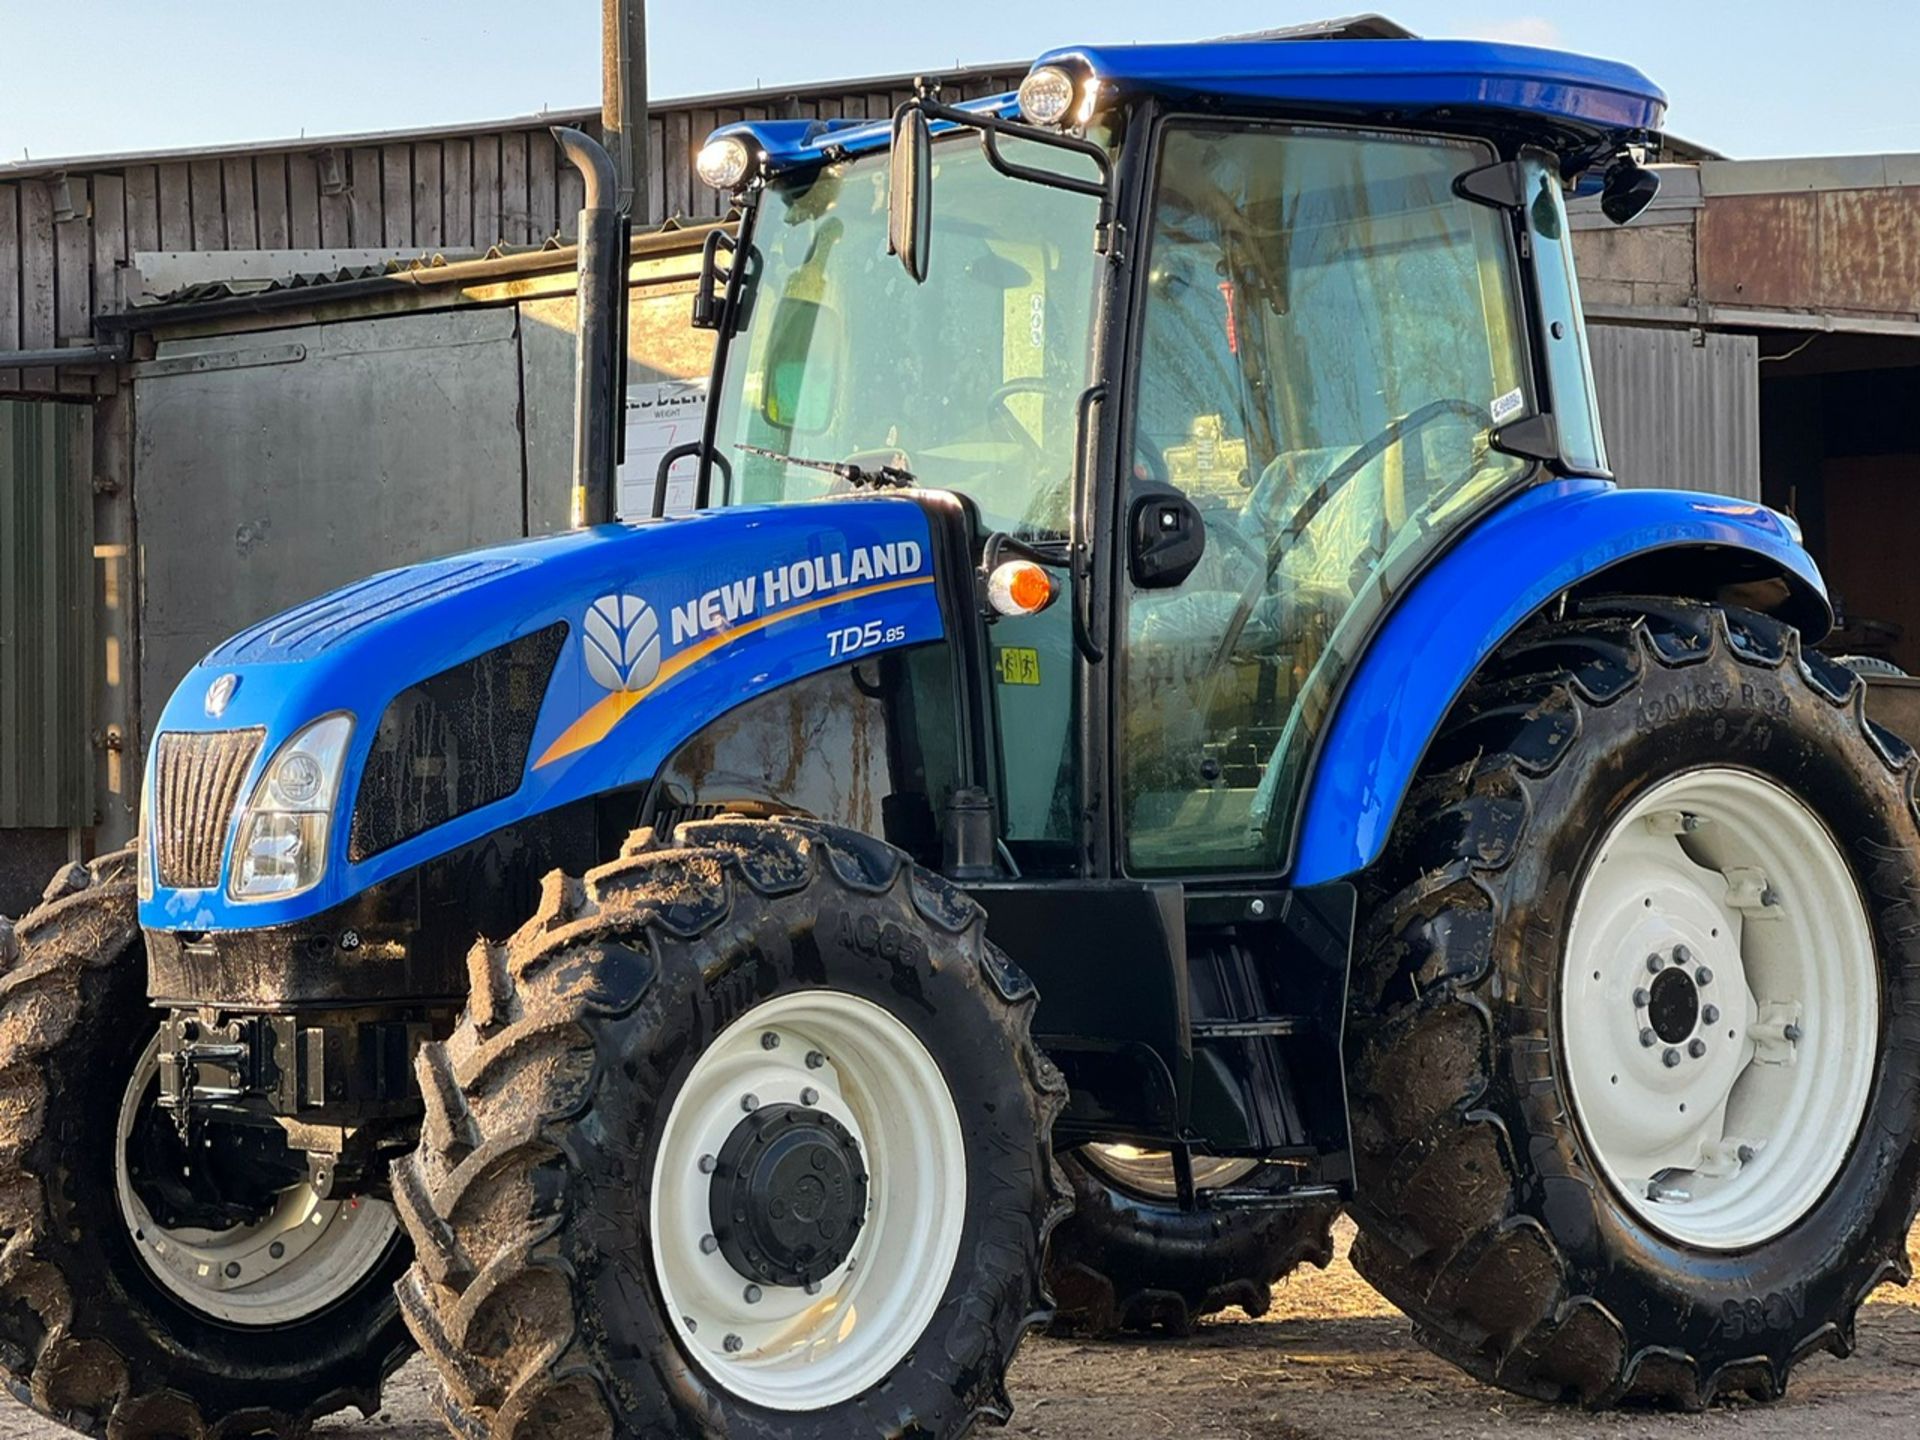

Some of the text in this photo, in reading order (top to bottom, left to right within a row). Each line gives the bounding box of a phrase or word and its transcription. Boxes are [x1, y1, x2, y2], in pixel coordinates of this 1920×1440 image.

[653, 408, 681, 419] WEIGHT
[671, 540, 922, 645] NEW HOLLAND
[826, 620, 905, 657] TD5.85
